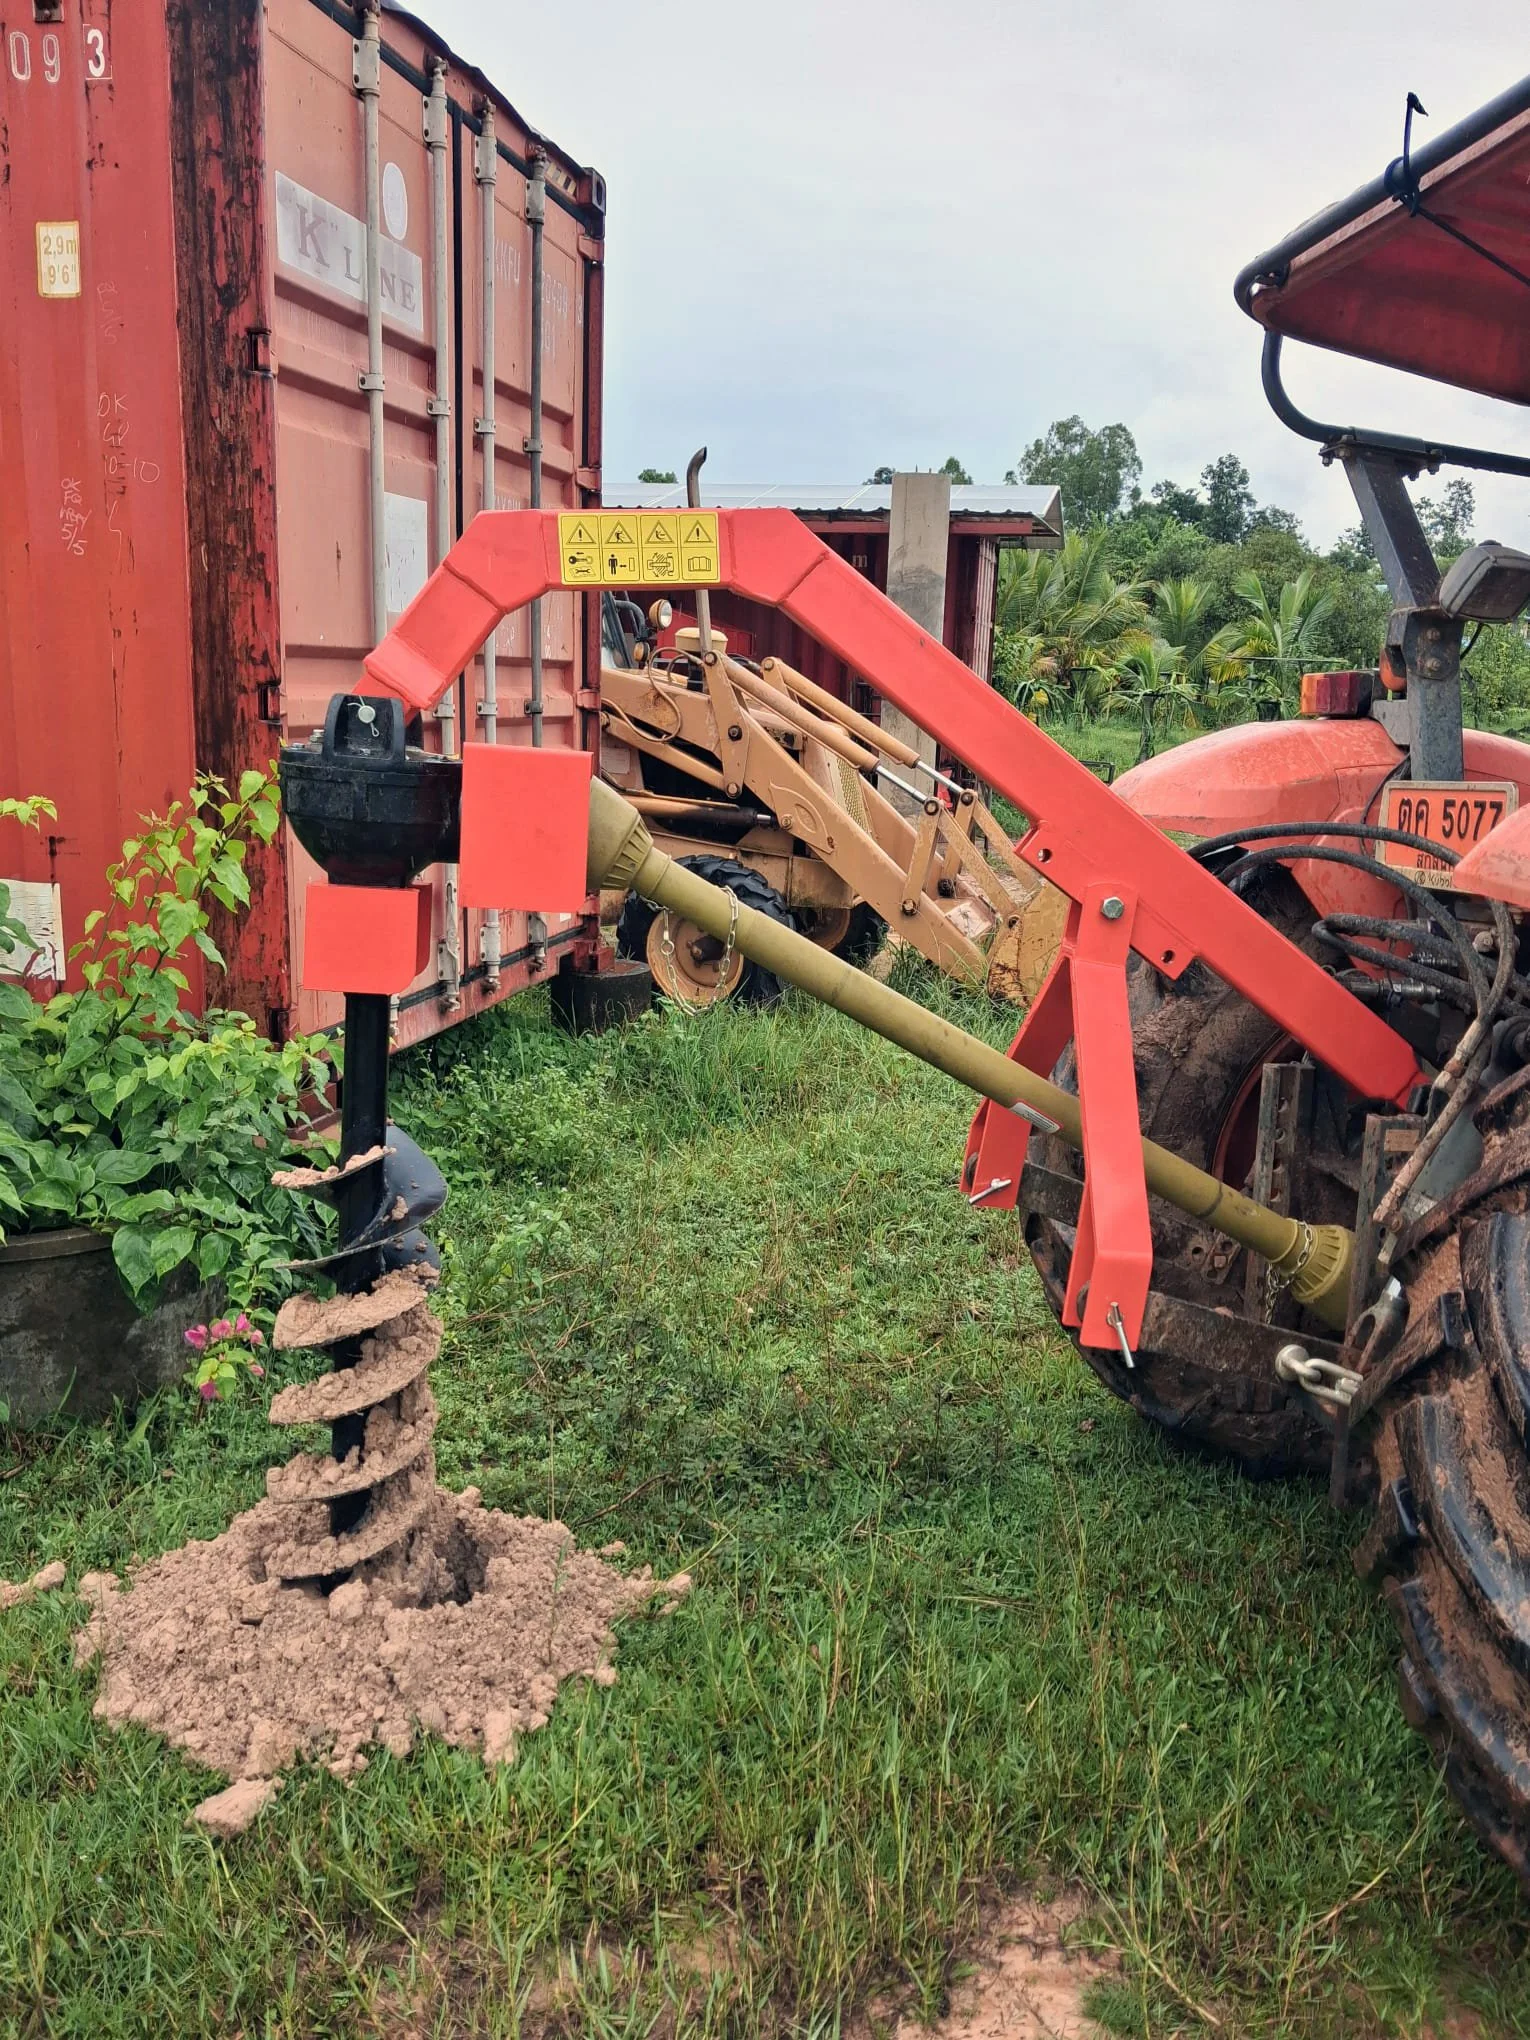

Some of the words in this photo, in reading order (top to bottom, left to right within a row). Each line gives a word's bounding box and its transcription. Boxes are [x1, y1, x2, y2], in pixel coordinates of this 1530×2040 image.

[87, 28, 106, 77] 3
[344, 245, 416, 313] LNE
[97, 392, 128, 417] OK
[61, 478, 81, 492] OK
[1441, 798, 1503, 841] 5077
